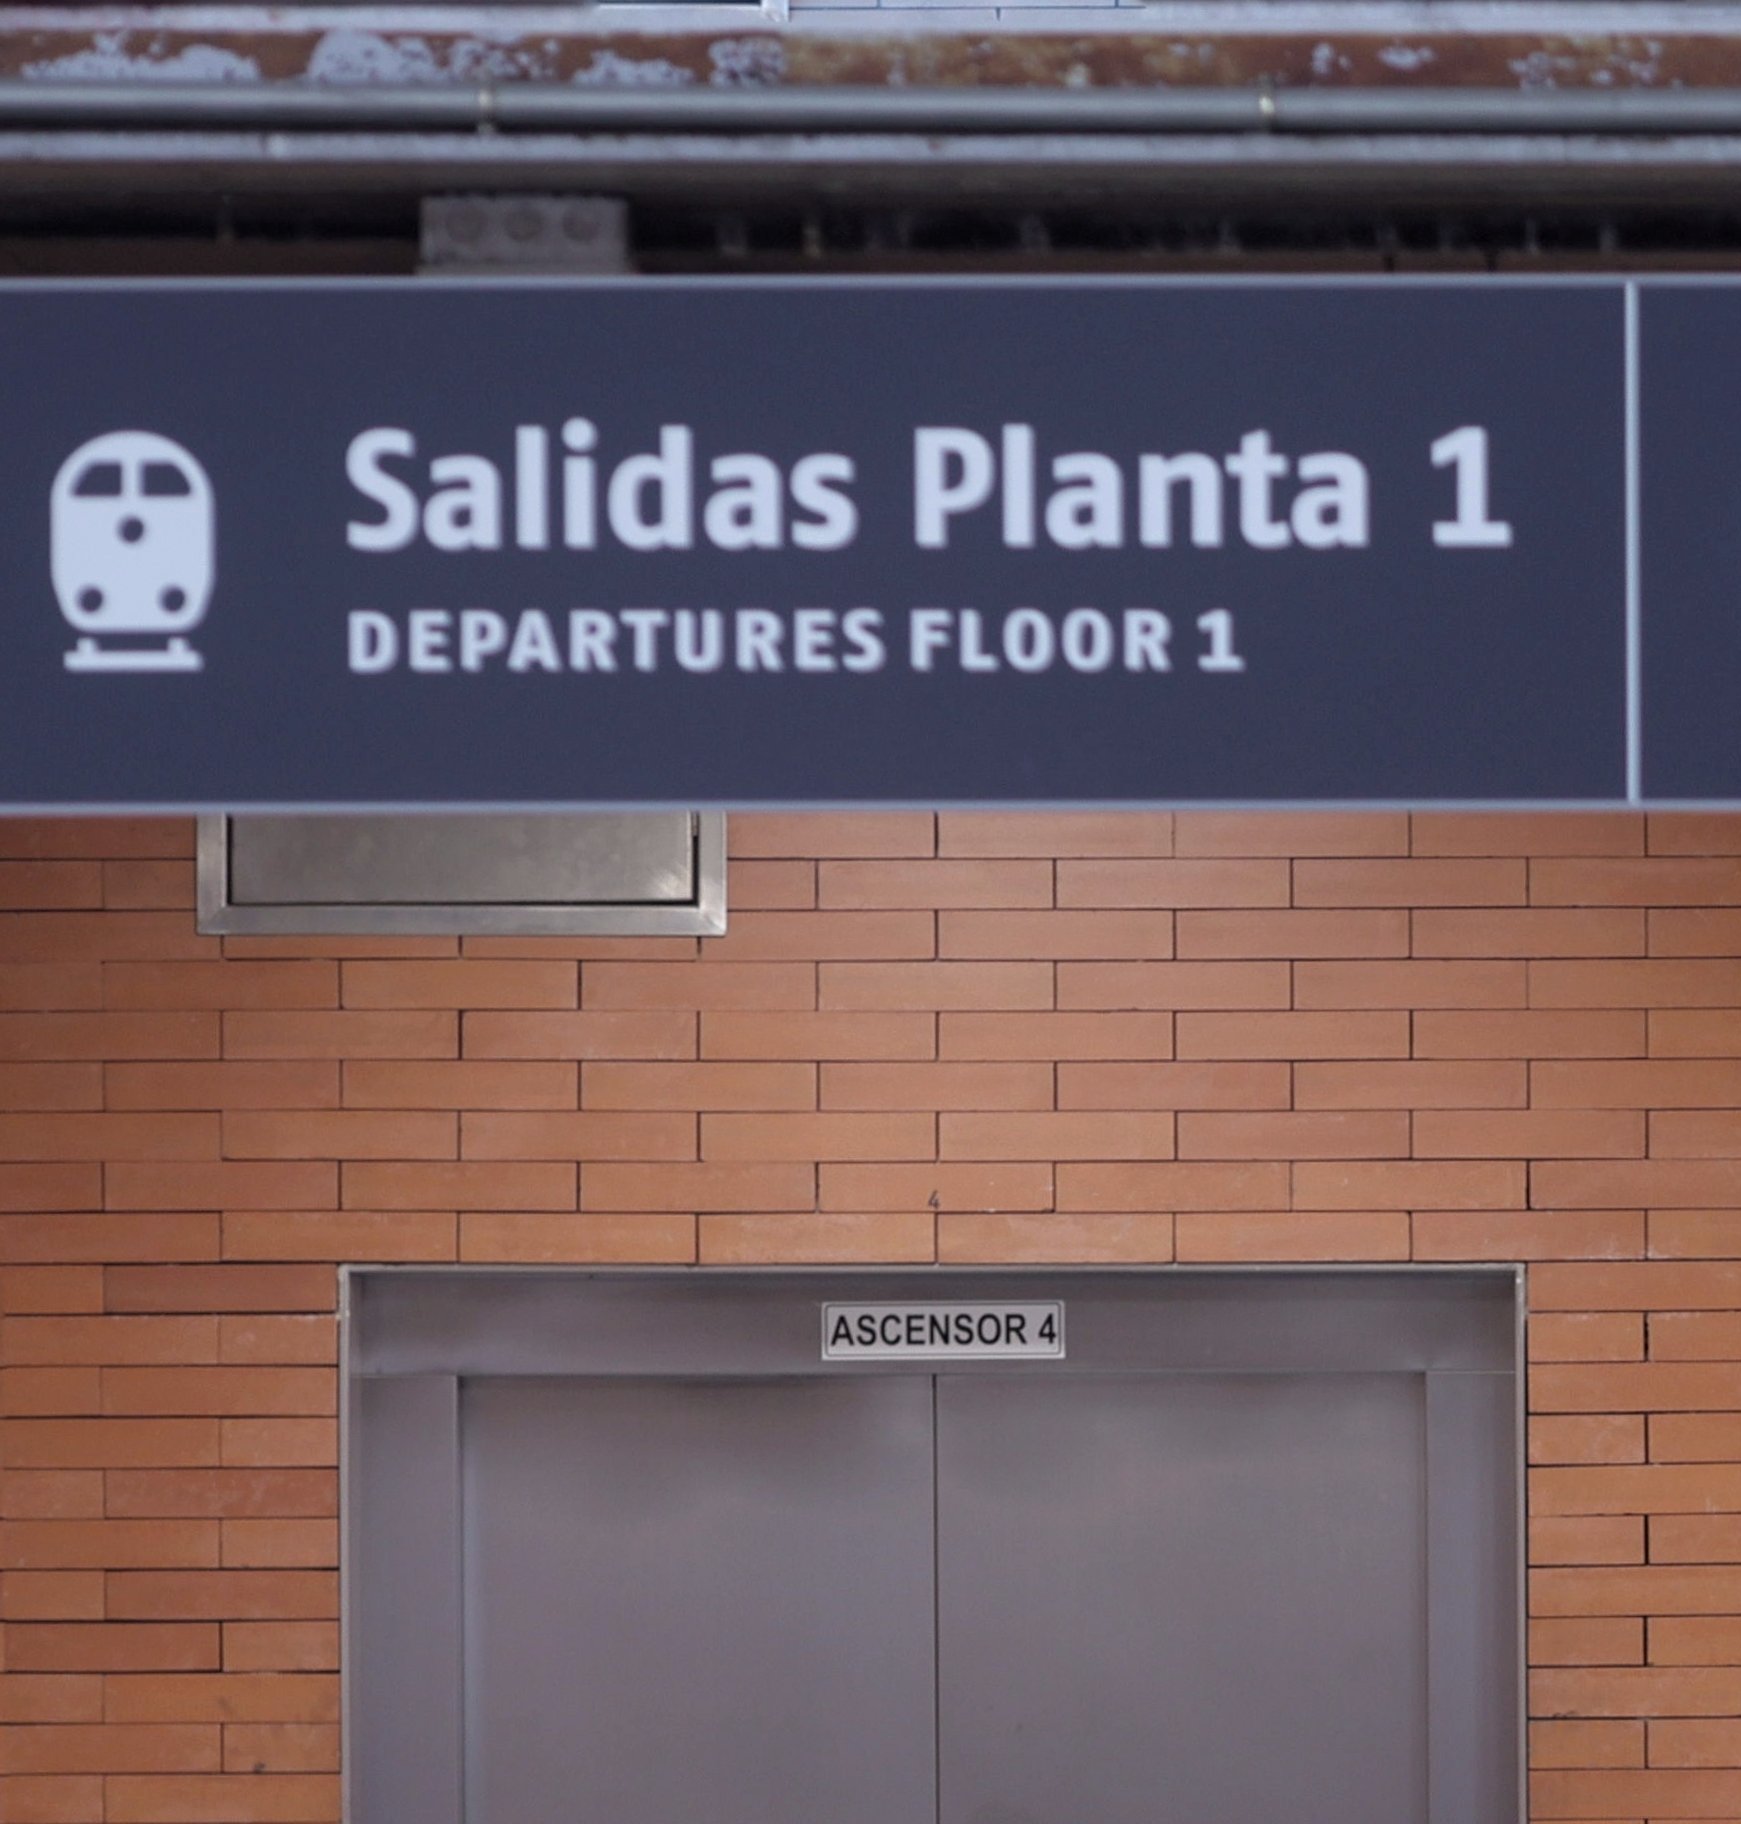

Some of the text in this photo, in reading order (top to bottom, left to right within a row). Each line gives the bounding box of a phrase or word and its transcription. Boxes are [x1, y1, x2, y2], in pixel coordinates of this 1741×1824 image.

[346, 418, 1512, 551] Salidas Planta 1
[348, 607, 1244, 673] DEPARTURES FLOOR 1
[830, 1313, 1057, 1347] ASCENSOR 4
